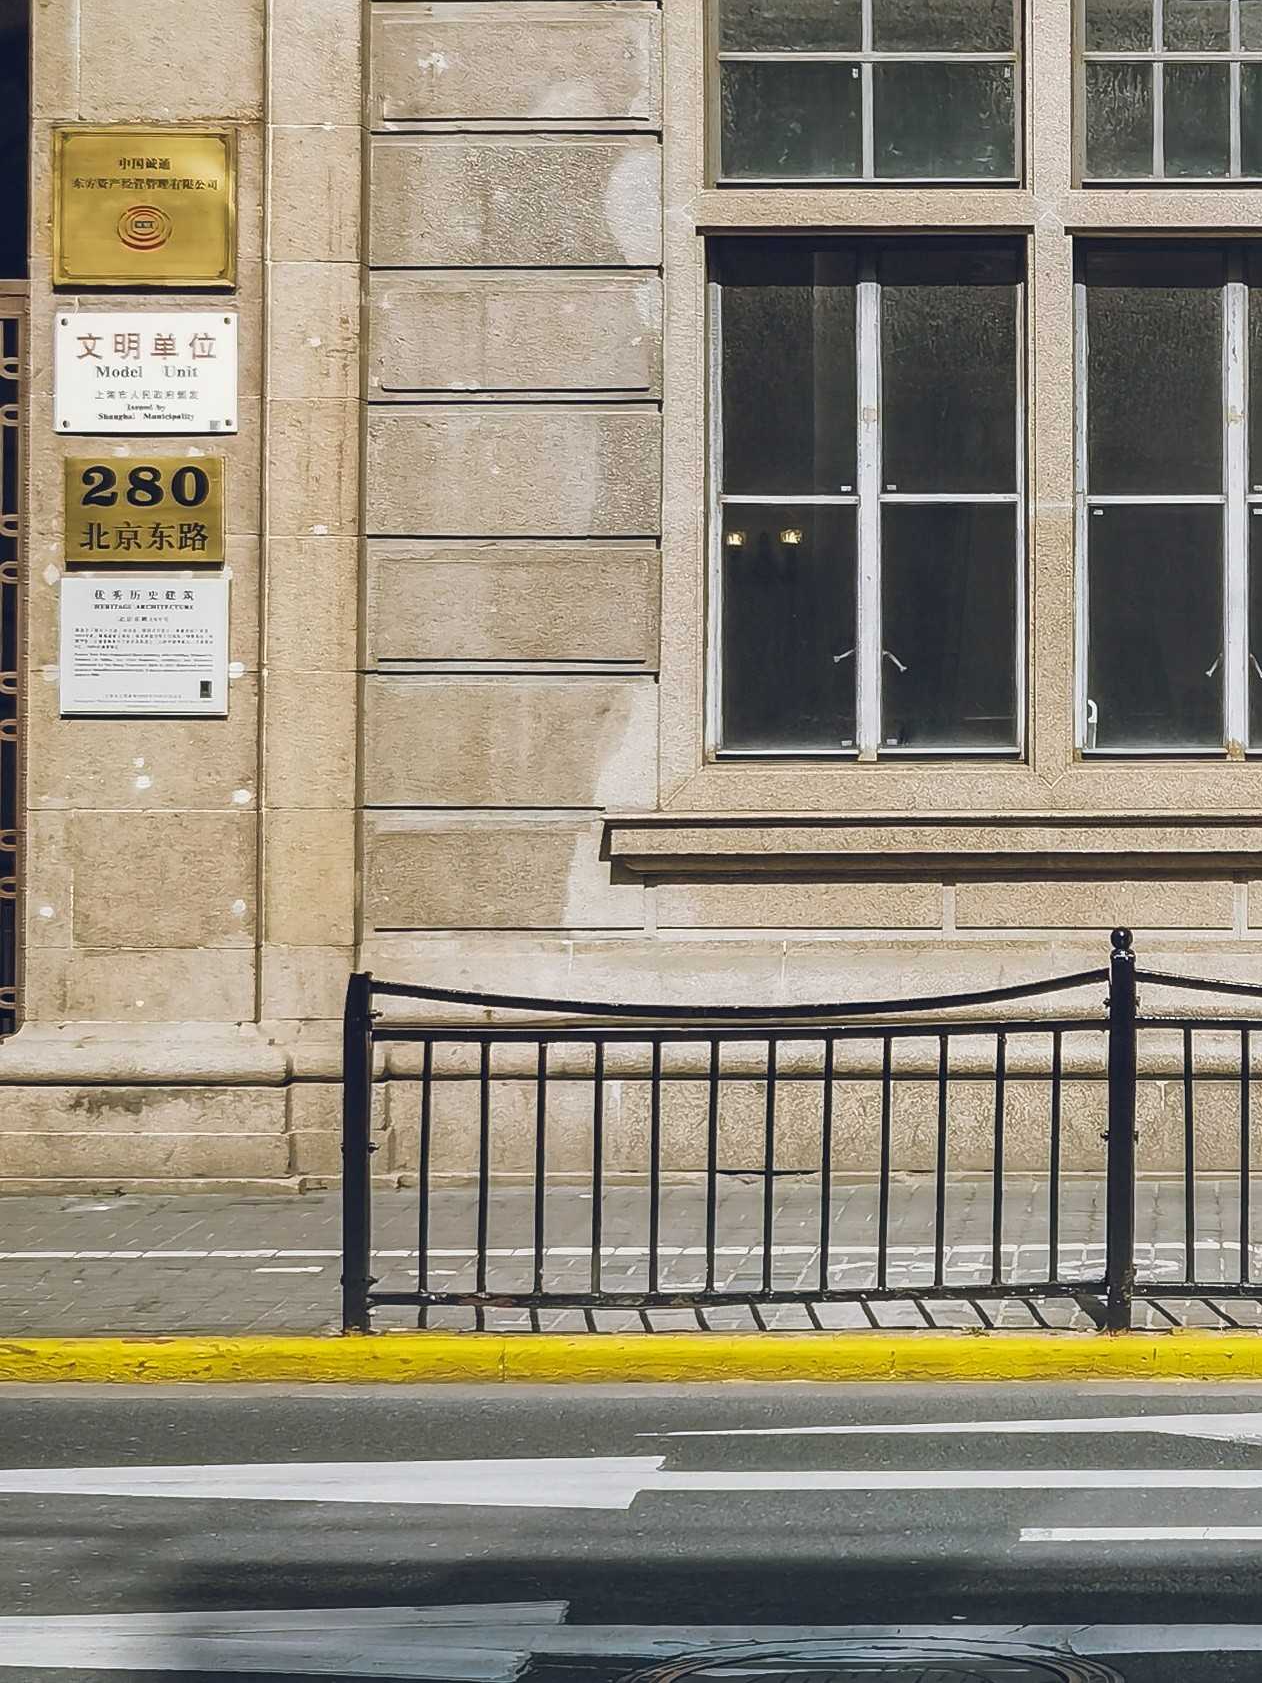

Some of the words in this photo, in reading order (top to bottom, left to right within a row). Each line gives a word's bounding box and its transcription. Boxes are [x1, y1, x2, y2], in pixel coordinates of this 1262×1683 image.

[76, 333, 217, 360] 文明单位
[95, 365, 144, 378] Model
[163, 365, 200, 378] Unit
[98, 413, 136, 421] Shanghai
[143, 413, 195, 421] Municipality
[81, 465, 210, 507] 280
[80, 522, 209, 552] 北京东路
